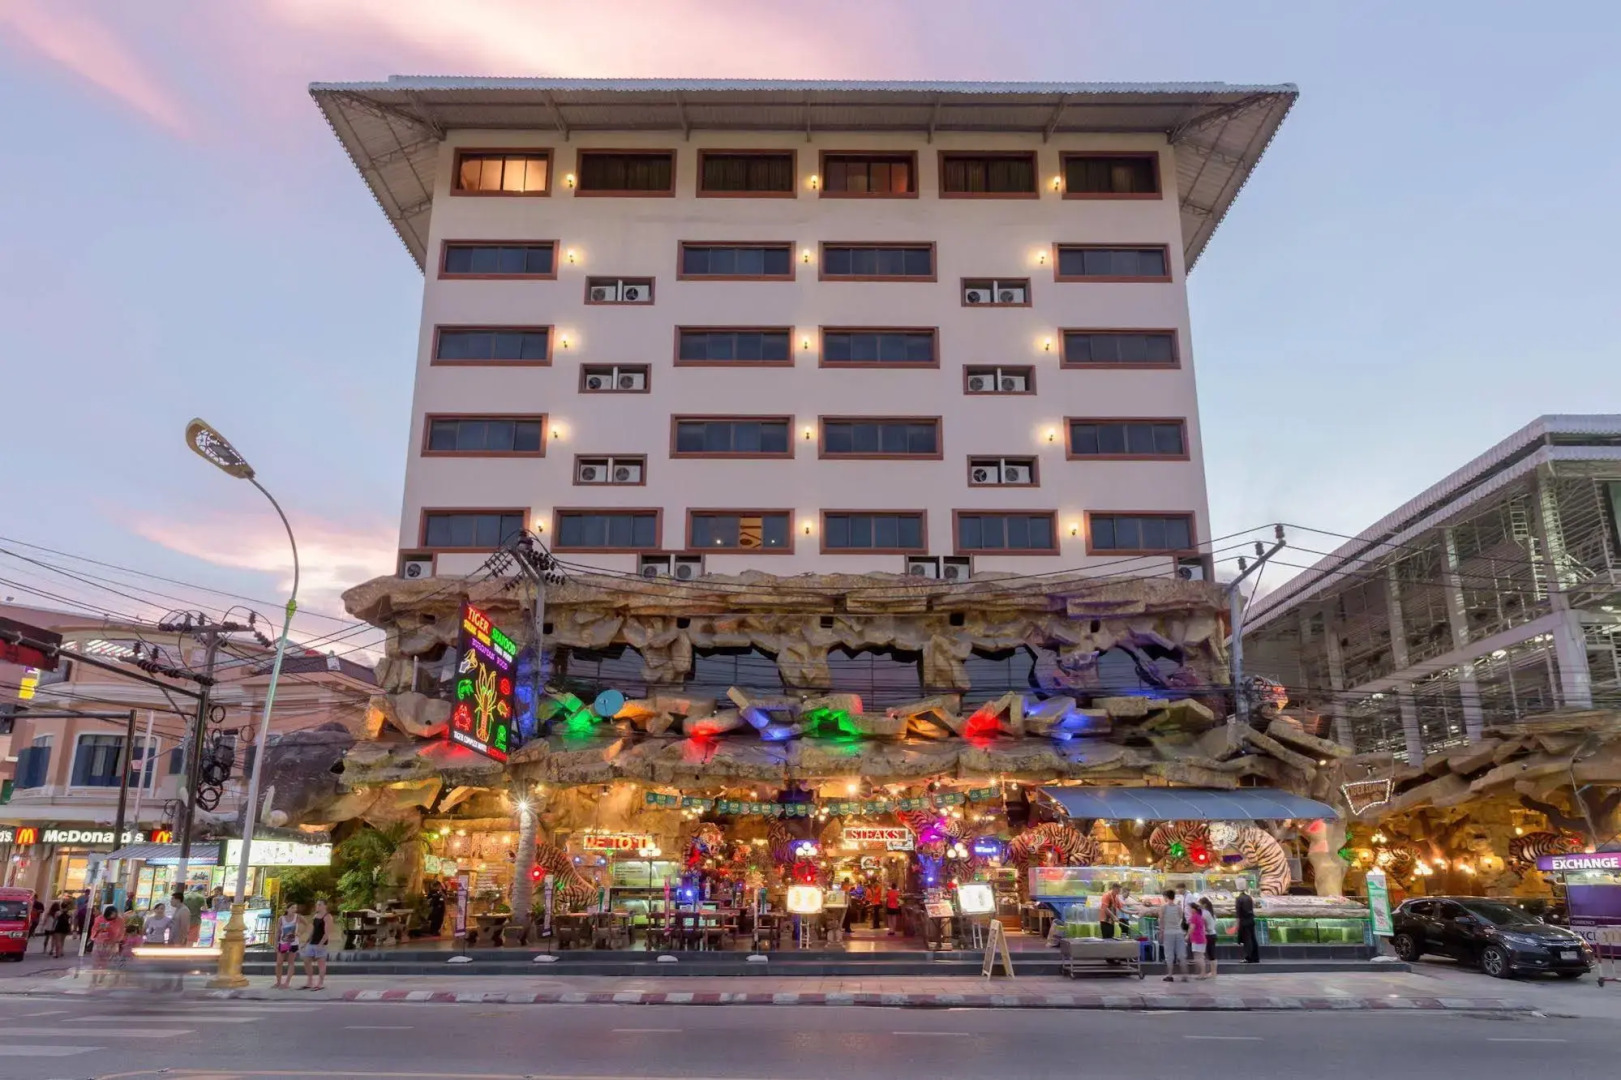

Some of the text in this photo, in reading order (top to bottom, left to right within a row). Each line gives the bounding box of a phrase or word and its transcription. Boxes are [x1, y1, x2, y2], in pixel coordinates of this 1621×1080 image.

[468, 606, 490, 635] TIGER
[43, 829, 146, 844] McDonads
[851, 830, 900, 840] STEAKS
[1552, 857, 1620, 870] EXCHANGE
